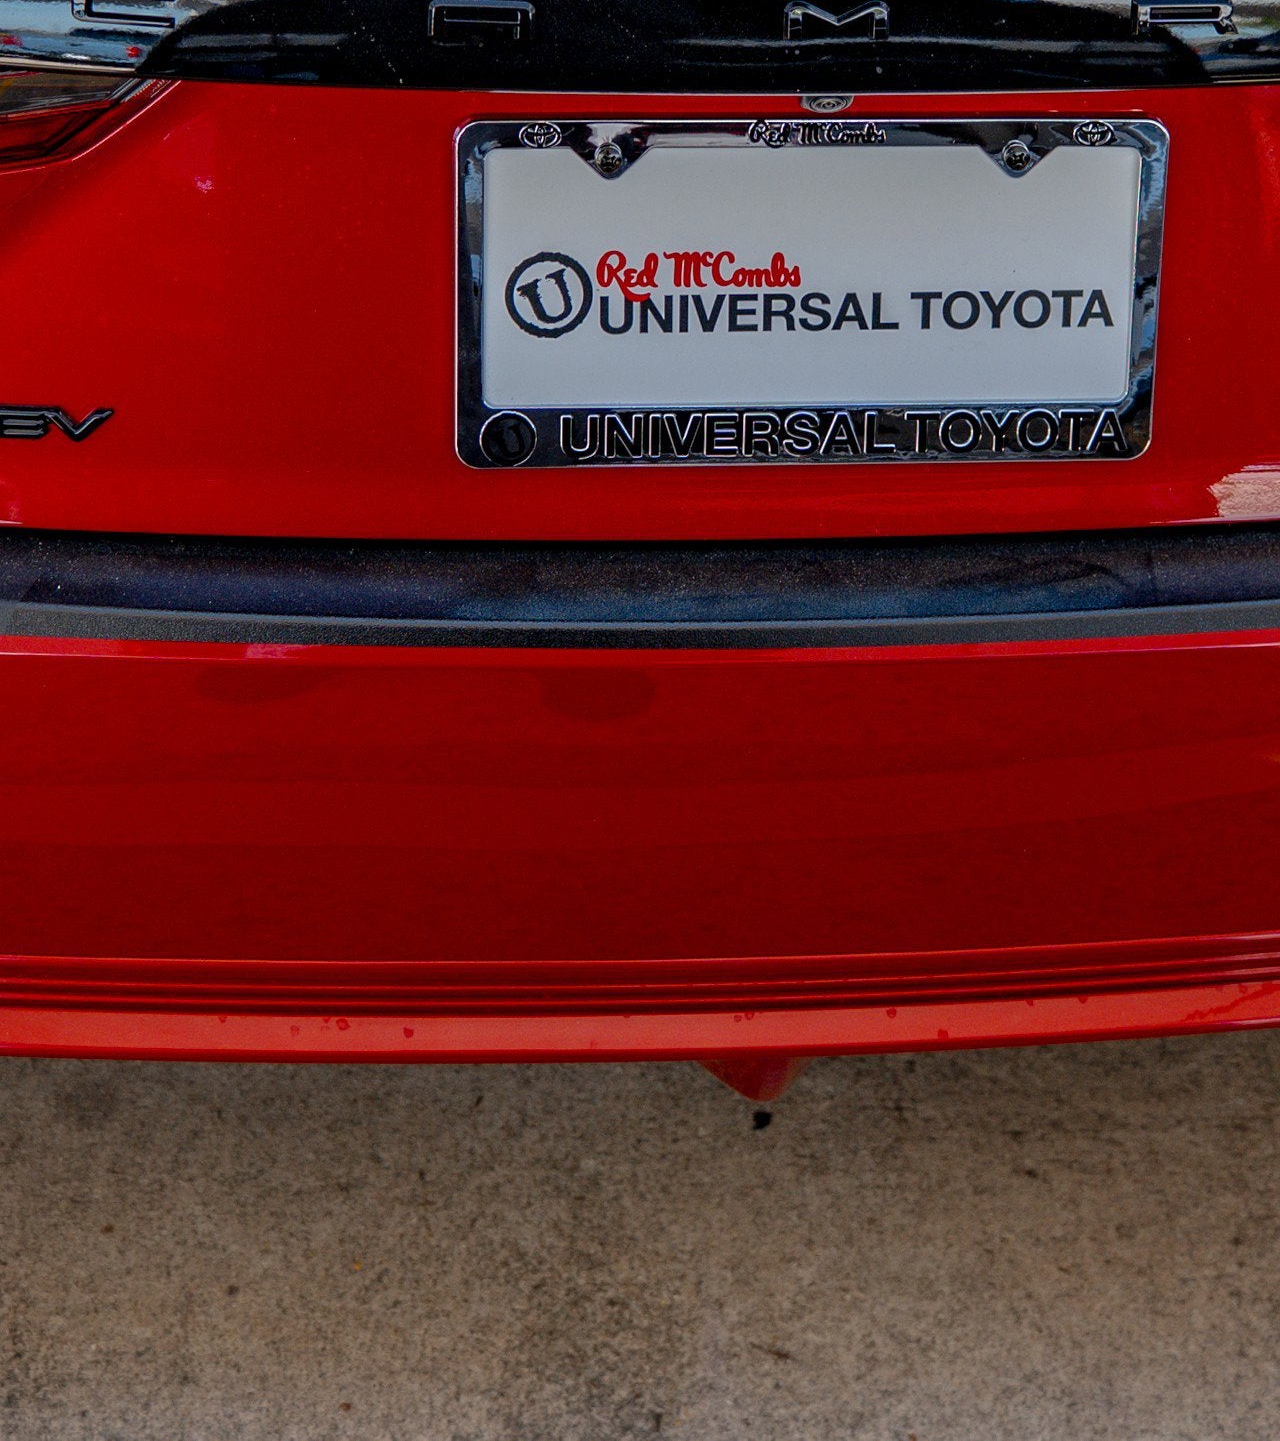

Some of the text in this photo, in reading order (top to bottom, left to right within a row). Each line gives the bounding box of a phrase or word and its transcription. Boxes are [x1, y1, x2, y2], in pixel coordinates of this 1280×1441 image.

[748, 119, 791, 148] Red
[596, 250, 802, 302] Red McCombs
[599, 288, 1114, 335] UNIVERSAL TOYOTA
[559, 408, 1127, 459] UNIVERSAL TOYOTA
